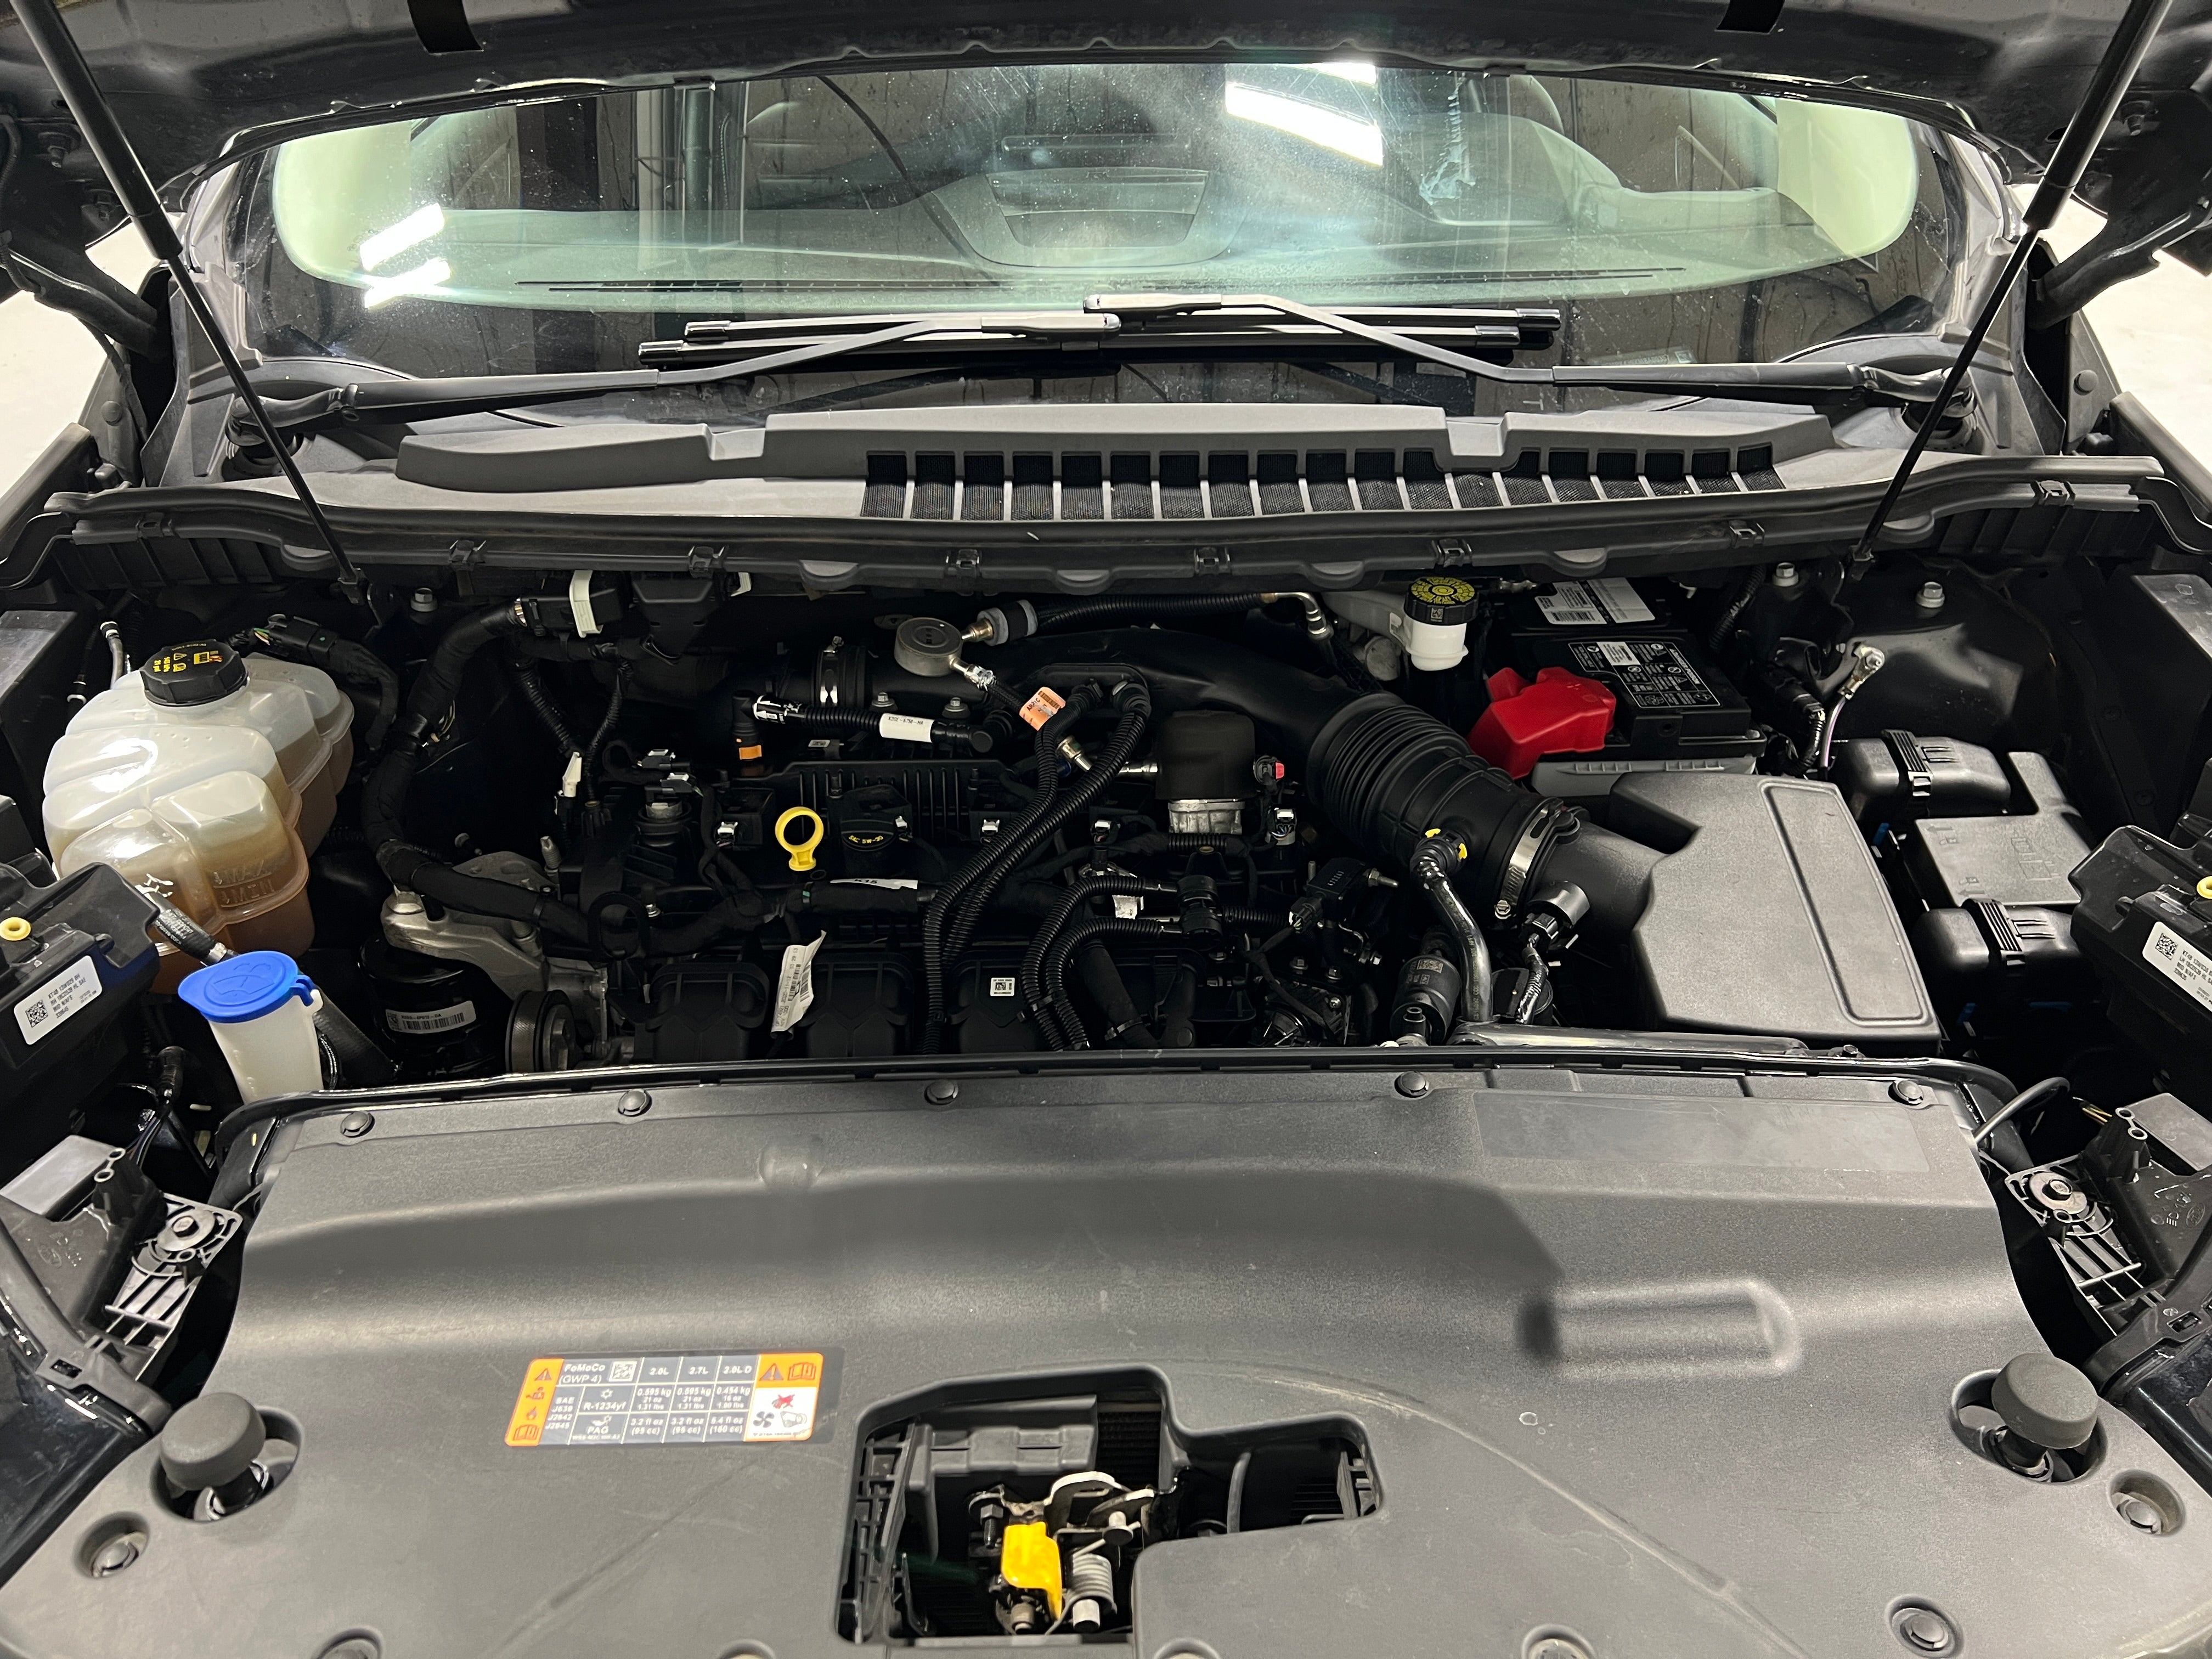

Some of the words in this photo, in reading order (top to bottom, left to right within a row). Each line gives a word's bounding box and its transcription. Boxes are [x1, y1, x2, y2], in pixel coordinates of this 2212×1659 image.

[862, 836, 883, 844] 5W-30
[231, 878, 275, 903] MIN
[565, 1363, 606, 1372] FoMoCo
[650, 1367, 669, 1375] 2.0L
[689, 1366, 709, 1375] 2.7L
[724, 1365, 743, 1374] 2.0L
[744, 1365, 752, 1374] D
[559, 1375, 590, 1385] (GWP
[591, 1374, 602, 1384] 4)
[637, 1387, 659, 1397] 0.595
[661, 1387, 672, 1398] kg
[677, 1387, 699, 1396] 0.595
[701, 1386, 712, 1397] kg
[716, 1386, 738, 1395] 0.454
[740, 1386, 751, 1396] kg
[583, 1401, 627, 1412] R-1234yf
[671, 1417, 684, 1425] 3.2
[725, 1416, 732, 1424] fl
[631, 1427, 645, 1436] (95
[646, 1426, 660, 1436] cc)
[672, 1426, 686, 1436] (95
[687, 1426, 701, 1435] cc)
[710, 1425, 728, 1435] (160
[730, 1425, 743, 1434] cc)
